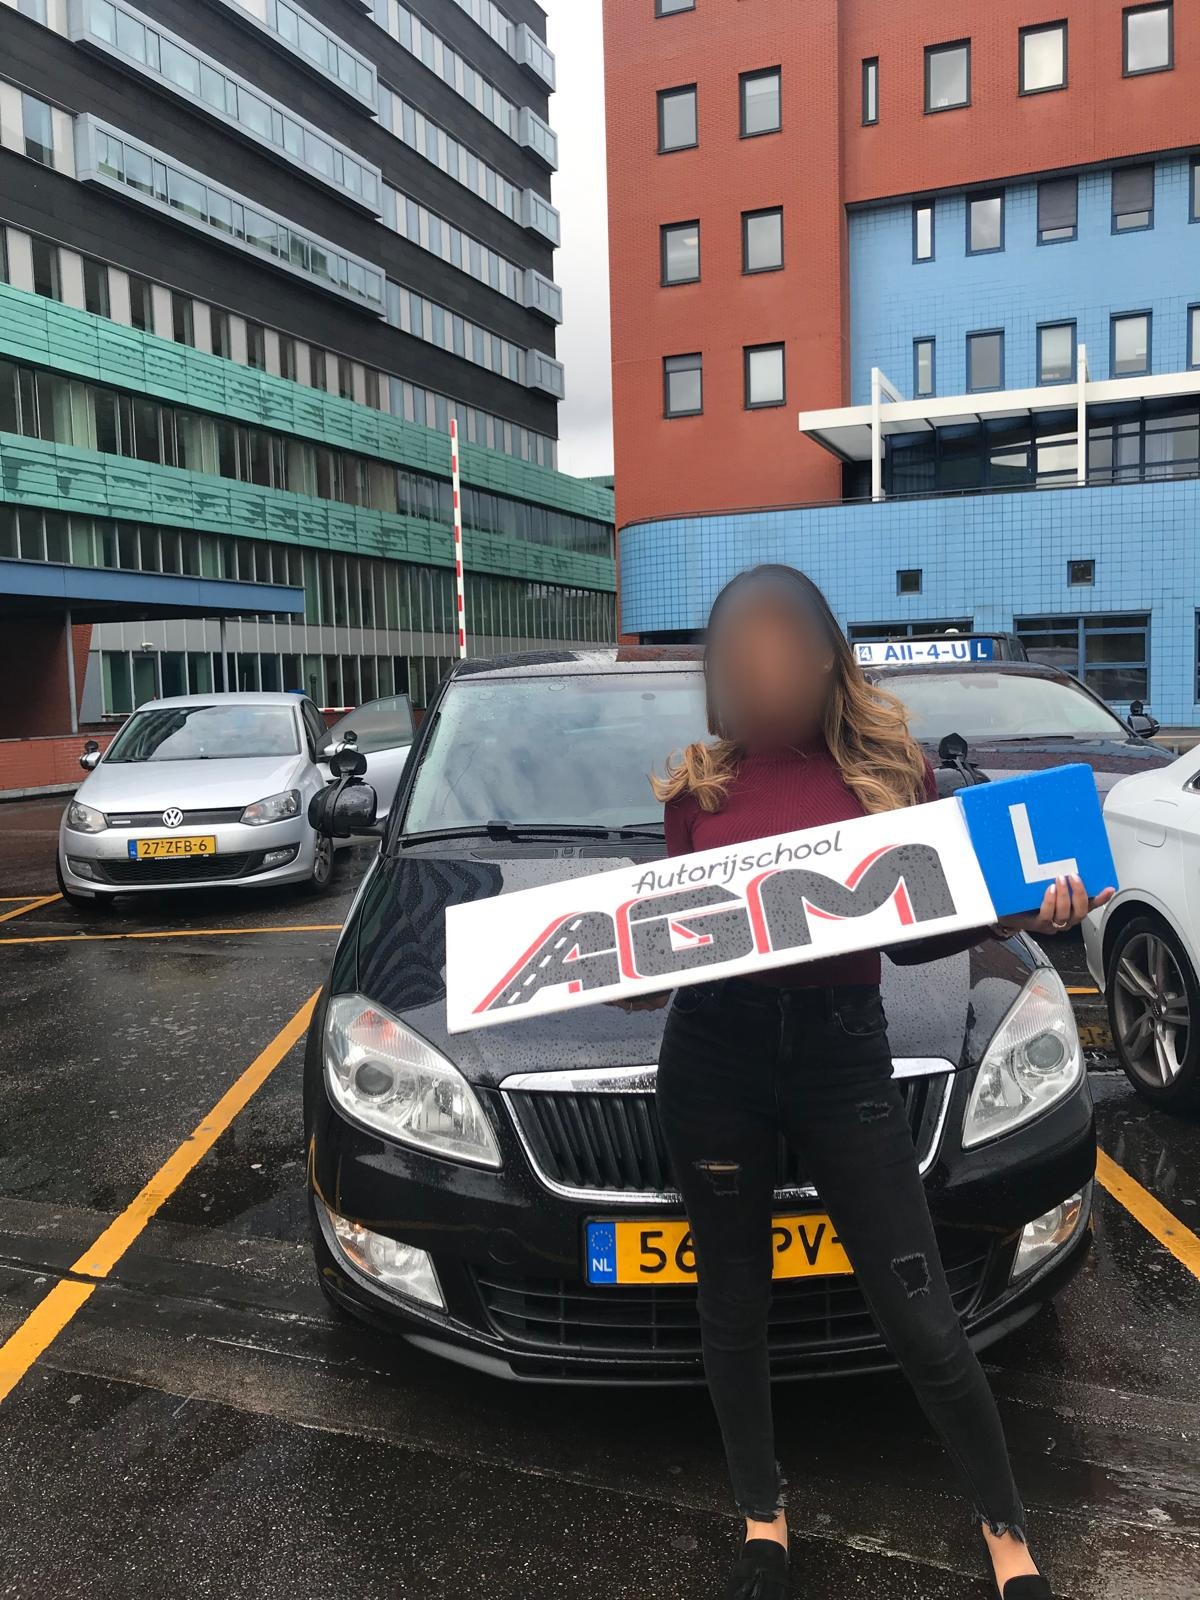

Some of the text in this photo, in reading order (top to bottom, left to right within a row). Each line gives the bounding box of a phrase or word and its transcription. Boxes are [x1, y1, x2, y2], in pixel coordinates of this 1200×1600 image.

[885, 643, 967, 661] All-4-U
[977, 643, 987, 658] L
[142, 839, 207, 855] 27-ZFB-6
[1009, 803, 1078, 884] L
[631, 830, 843, 894] Autorijschool
[471, 843, 957, 1014] AGM
[592, 1258, 613, 1272] NL
